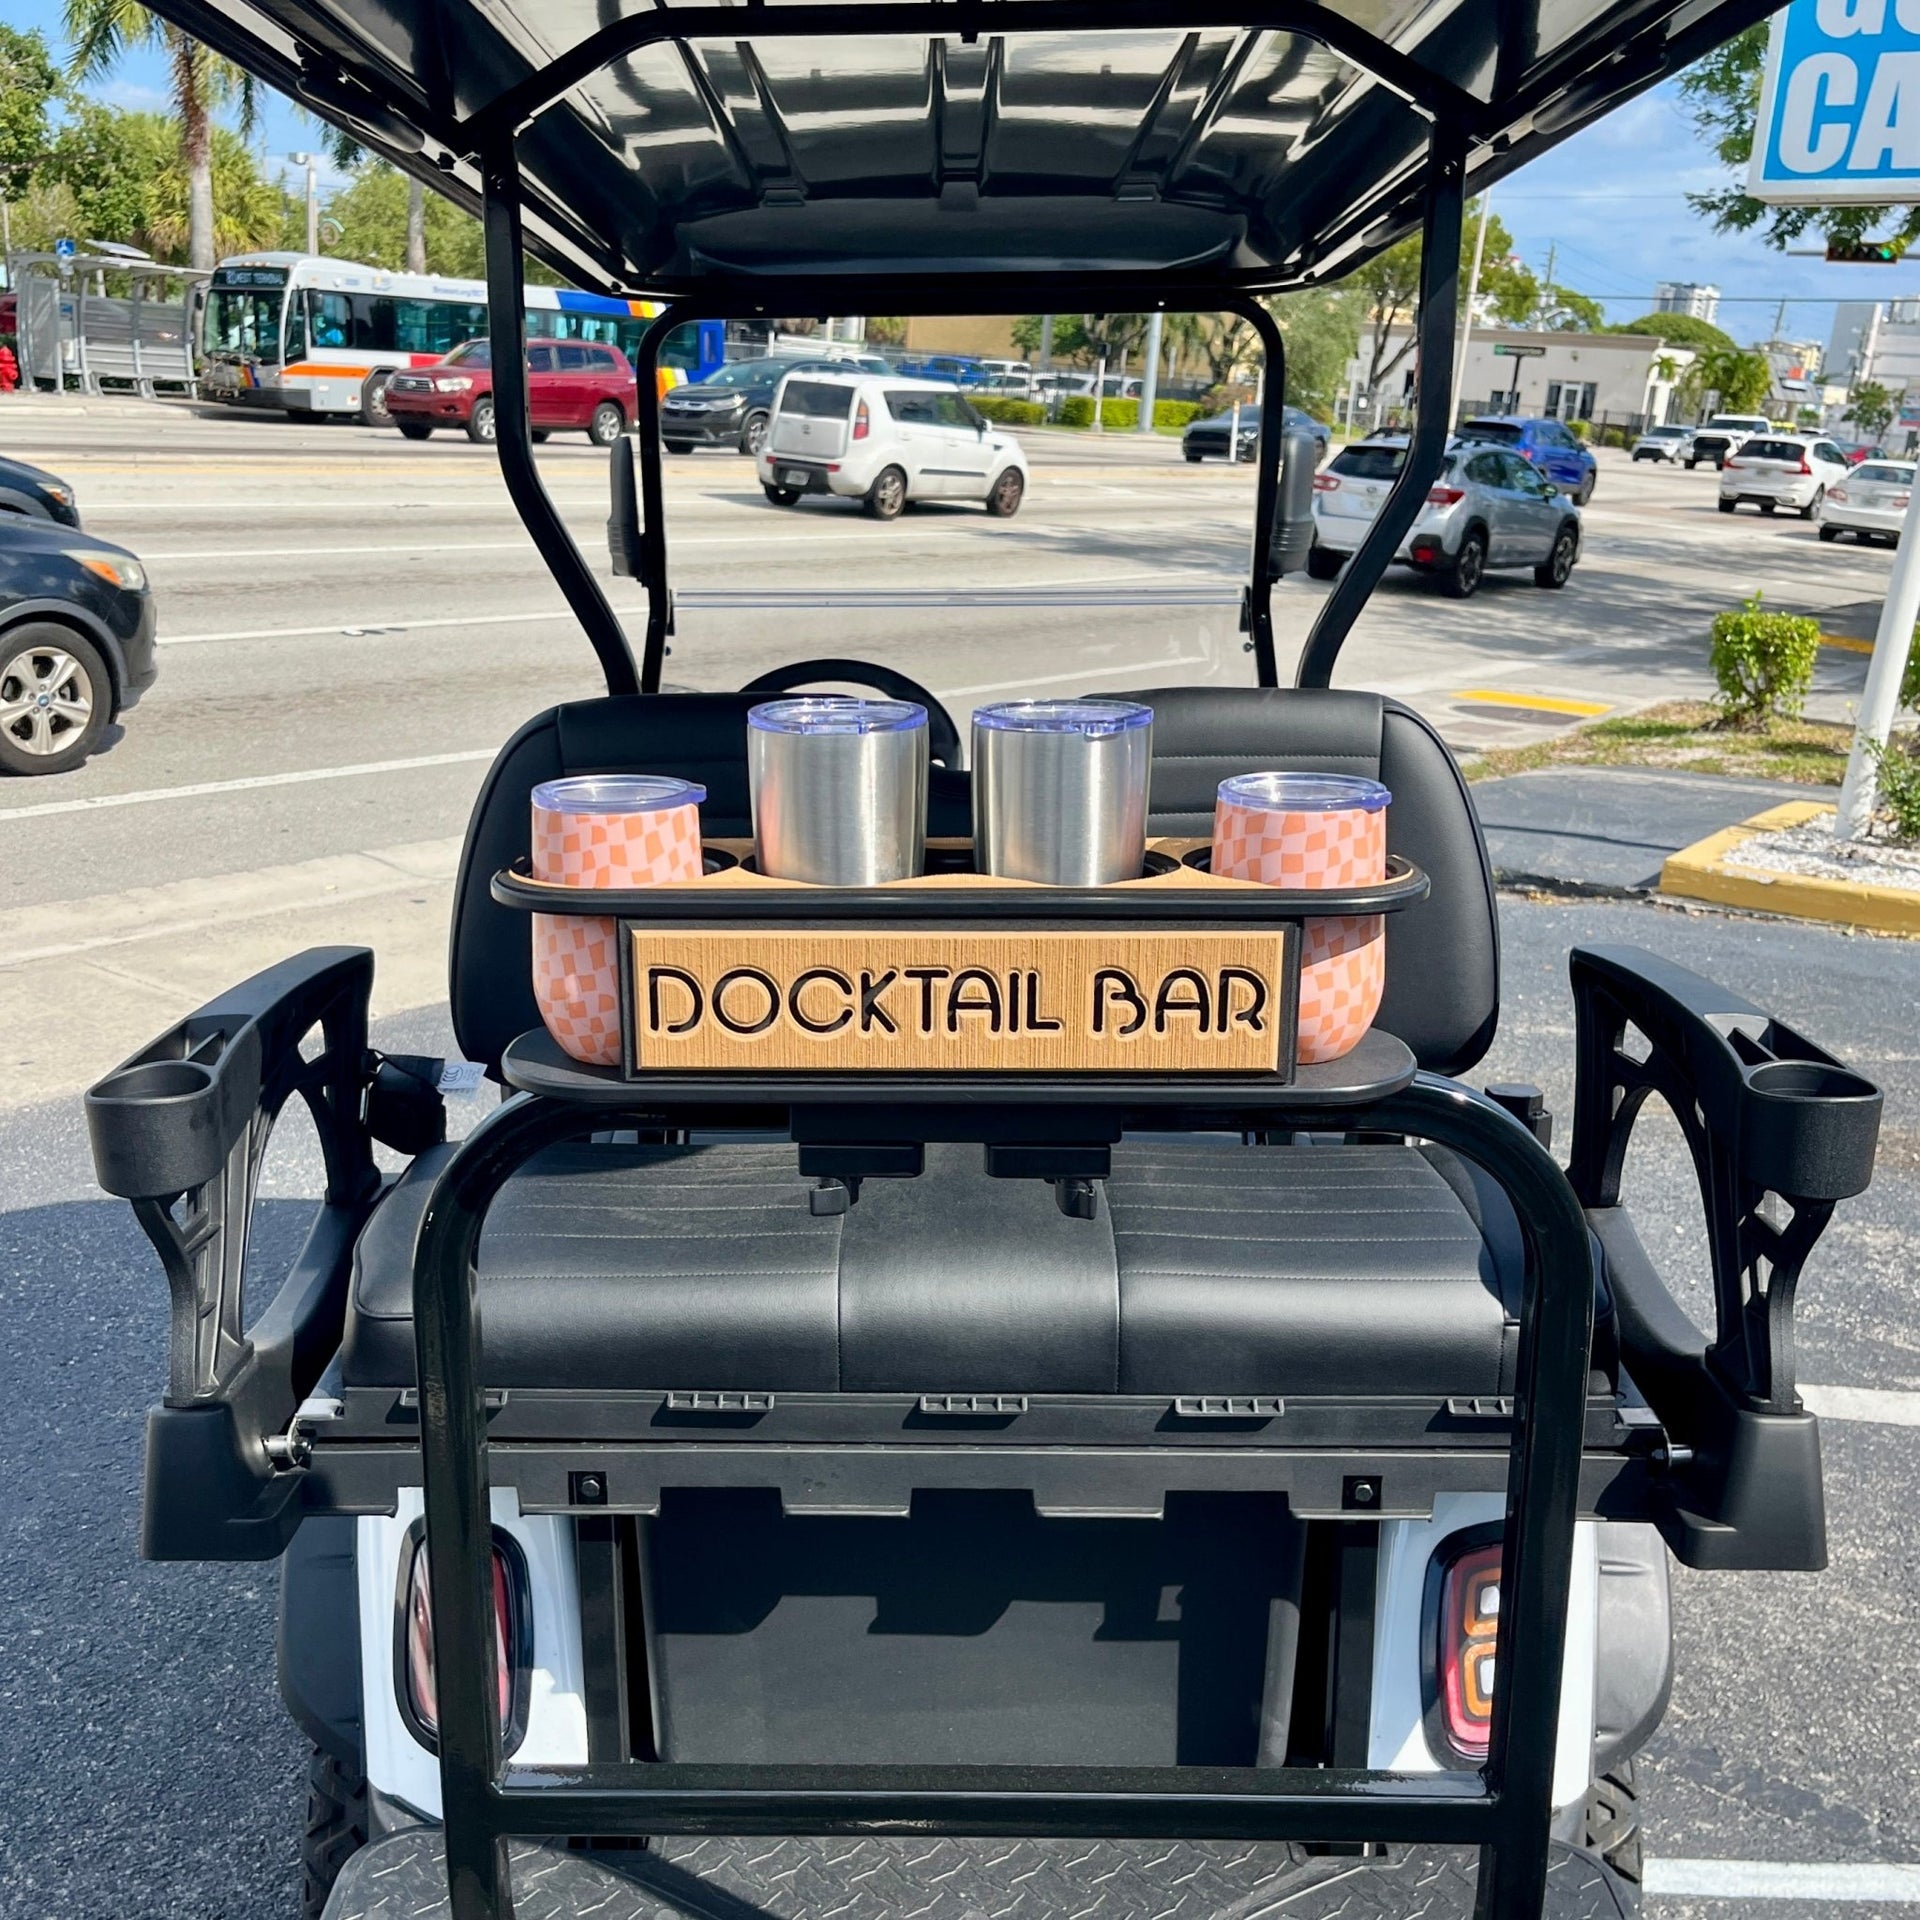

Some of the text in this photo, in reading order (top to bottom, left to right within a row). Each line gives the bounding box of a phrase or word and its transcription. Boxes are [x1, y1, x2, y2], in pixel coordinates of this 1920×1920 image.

[1779, 52, 1920, 174] CA
[648, 967, 1265, 1035] DOCKTAIL BAR
